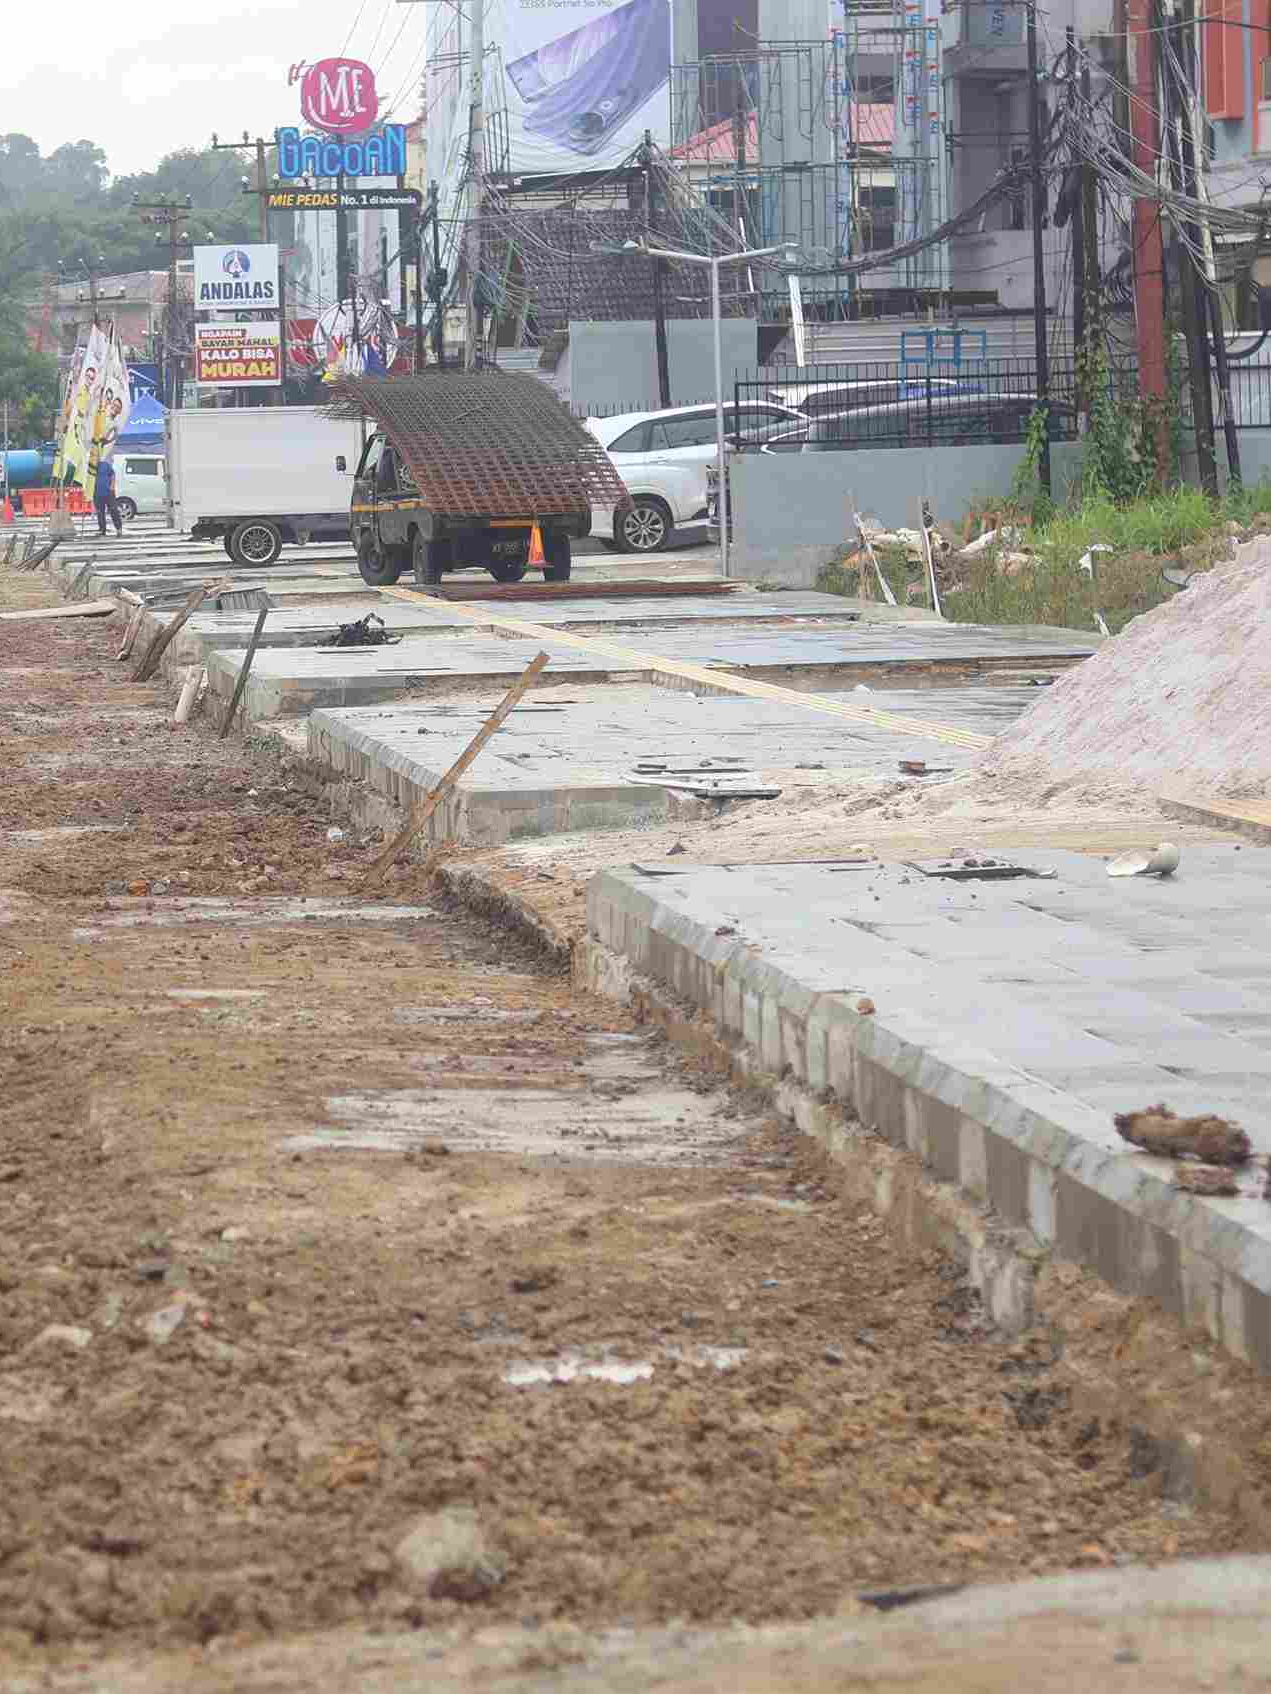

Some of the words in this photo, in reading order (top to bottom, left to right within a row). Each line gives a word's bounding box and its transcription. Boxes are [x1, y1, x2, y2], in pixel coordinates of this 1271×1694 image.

[281, 125, 406, 177] GACOAN
[269, 194, 294, 206] MIE
[297, 194, 337, 206] PEDAS
[340, 195, 359, 205] No.
[200, 281, 275, 300] ANDALAS
[201, 350, 240, 360] KALO
[242, 349, 275, 359] BISA
[201, 362, 276, 377] MURAH
